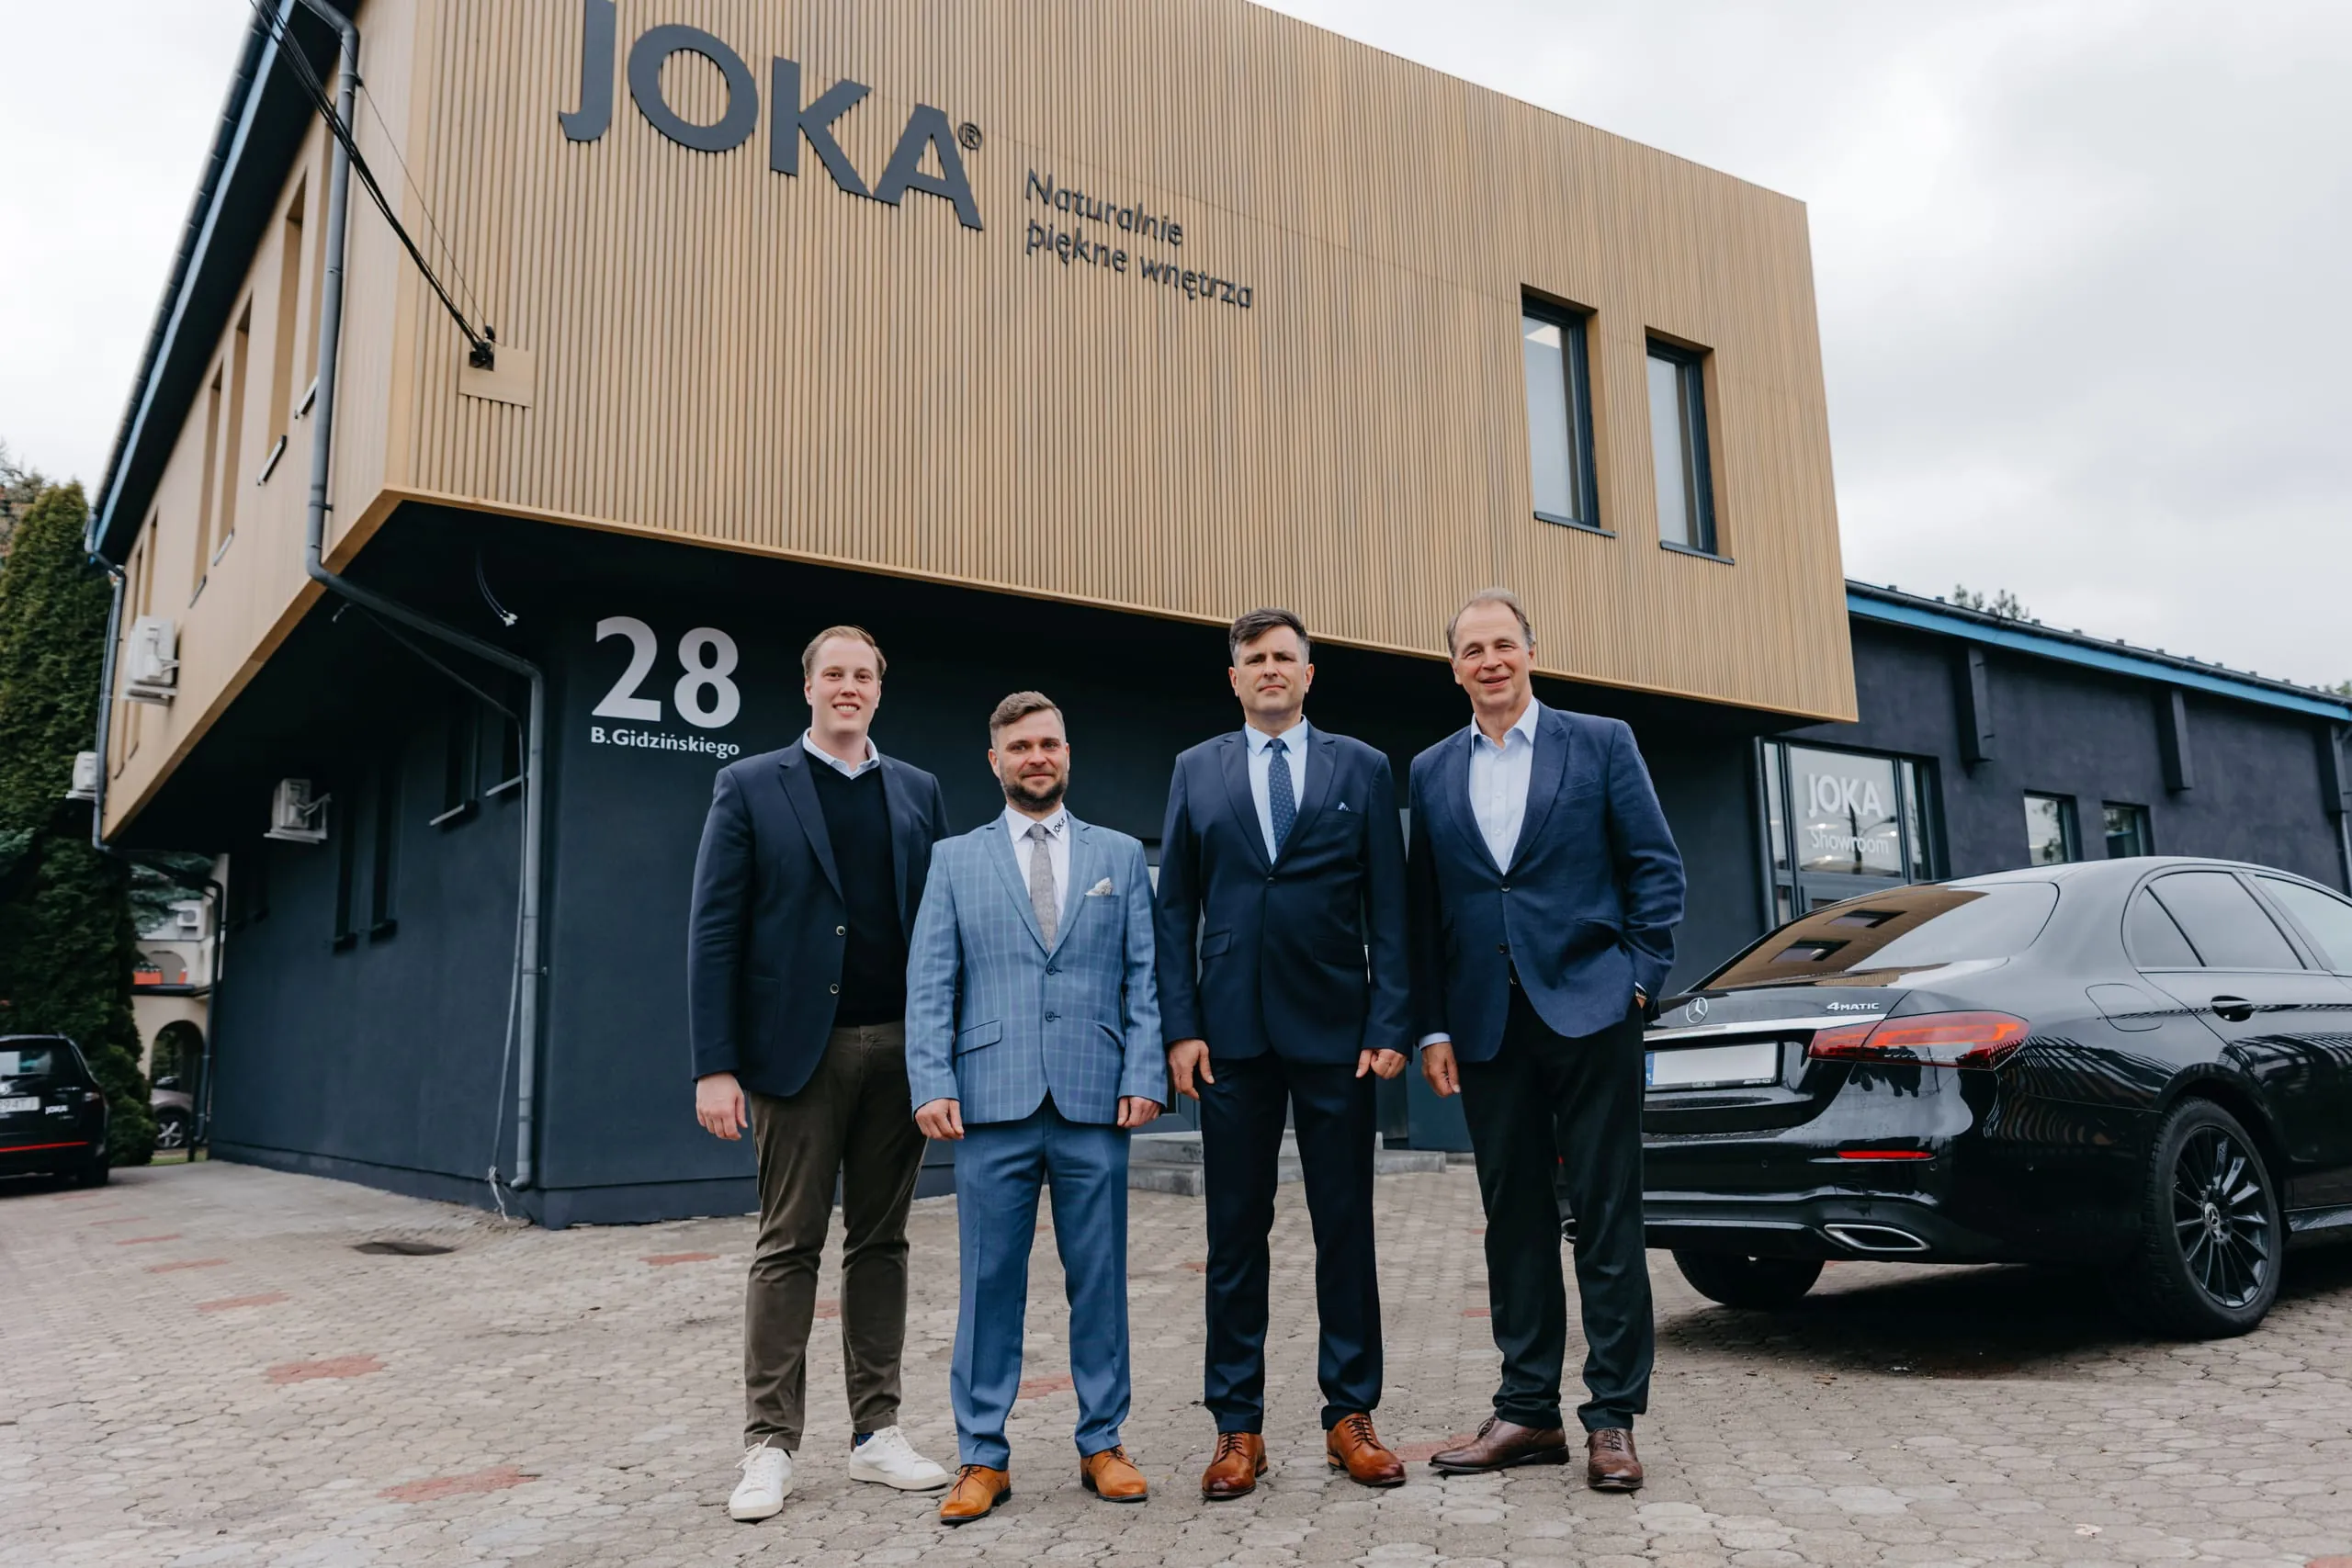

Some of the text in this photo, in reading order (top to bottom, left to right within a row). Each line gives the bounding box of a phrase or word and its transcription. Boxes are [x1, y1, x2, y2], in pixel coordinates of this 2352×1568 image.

[1026, 168, 1183, 245] Naturalnie
[1026, 219, 1252, 309] piękne wnętrza
[592, 615, 741, 728] 28
[591, 727, 740, 760] B.Gidzińskiego
[1806, 773, 1884, 818] JOKA
[1810, 829, 1889, 854] Showroom
[1826, 1001, 1880, 1010] 4MATIC
